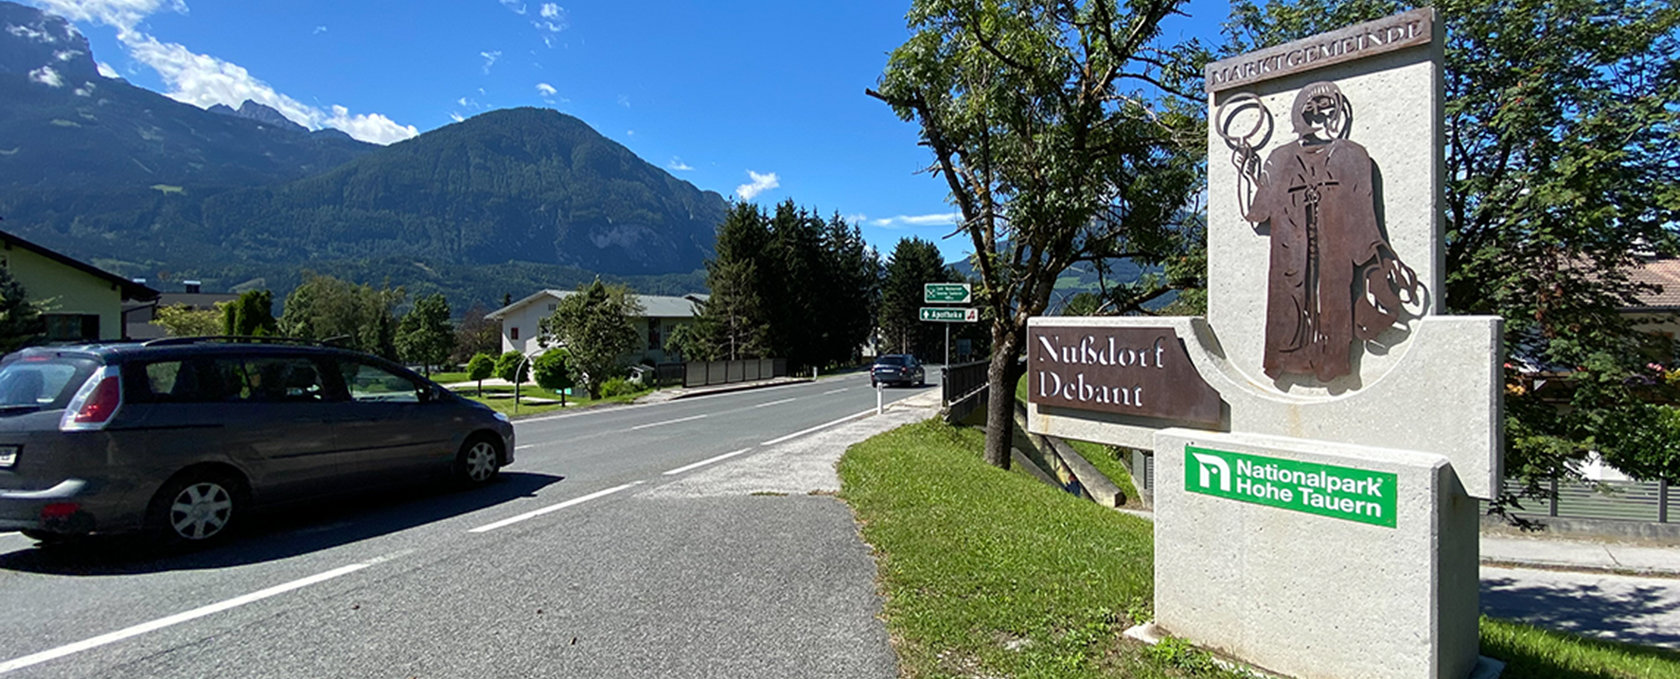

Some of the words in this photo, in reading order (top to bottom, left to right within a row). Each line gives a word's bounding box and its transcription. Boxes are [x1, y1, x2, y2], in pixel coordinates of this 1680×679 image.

[1211, 20, 1424, 86] MARKTGEMEINDE
[1036, 333, 1166, 369] Nußdorf
[1037, 368, 1144, 408] Debant
[1236, 458, 1383, 498] Nationalpark
[1236, 477, 1293, 502] Hohe
[1297, 487, 1382, 518] Tauern
